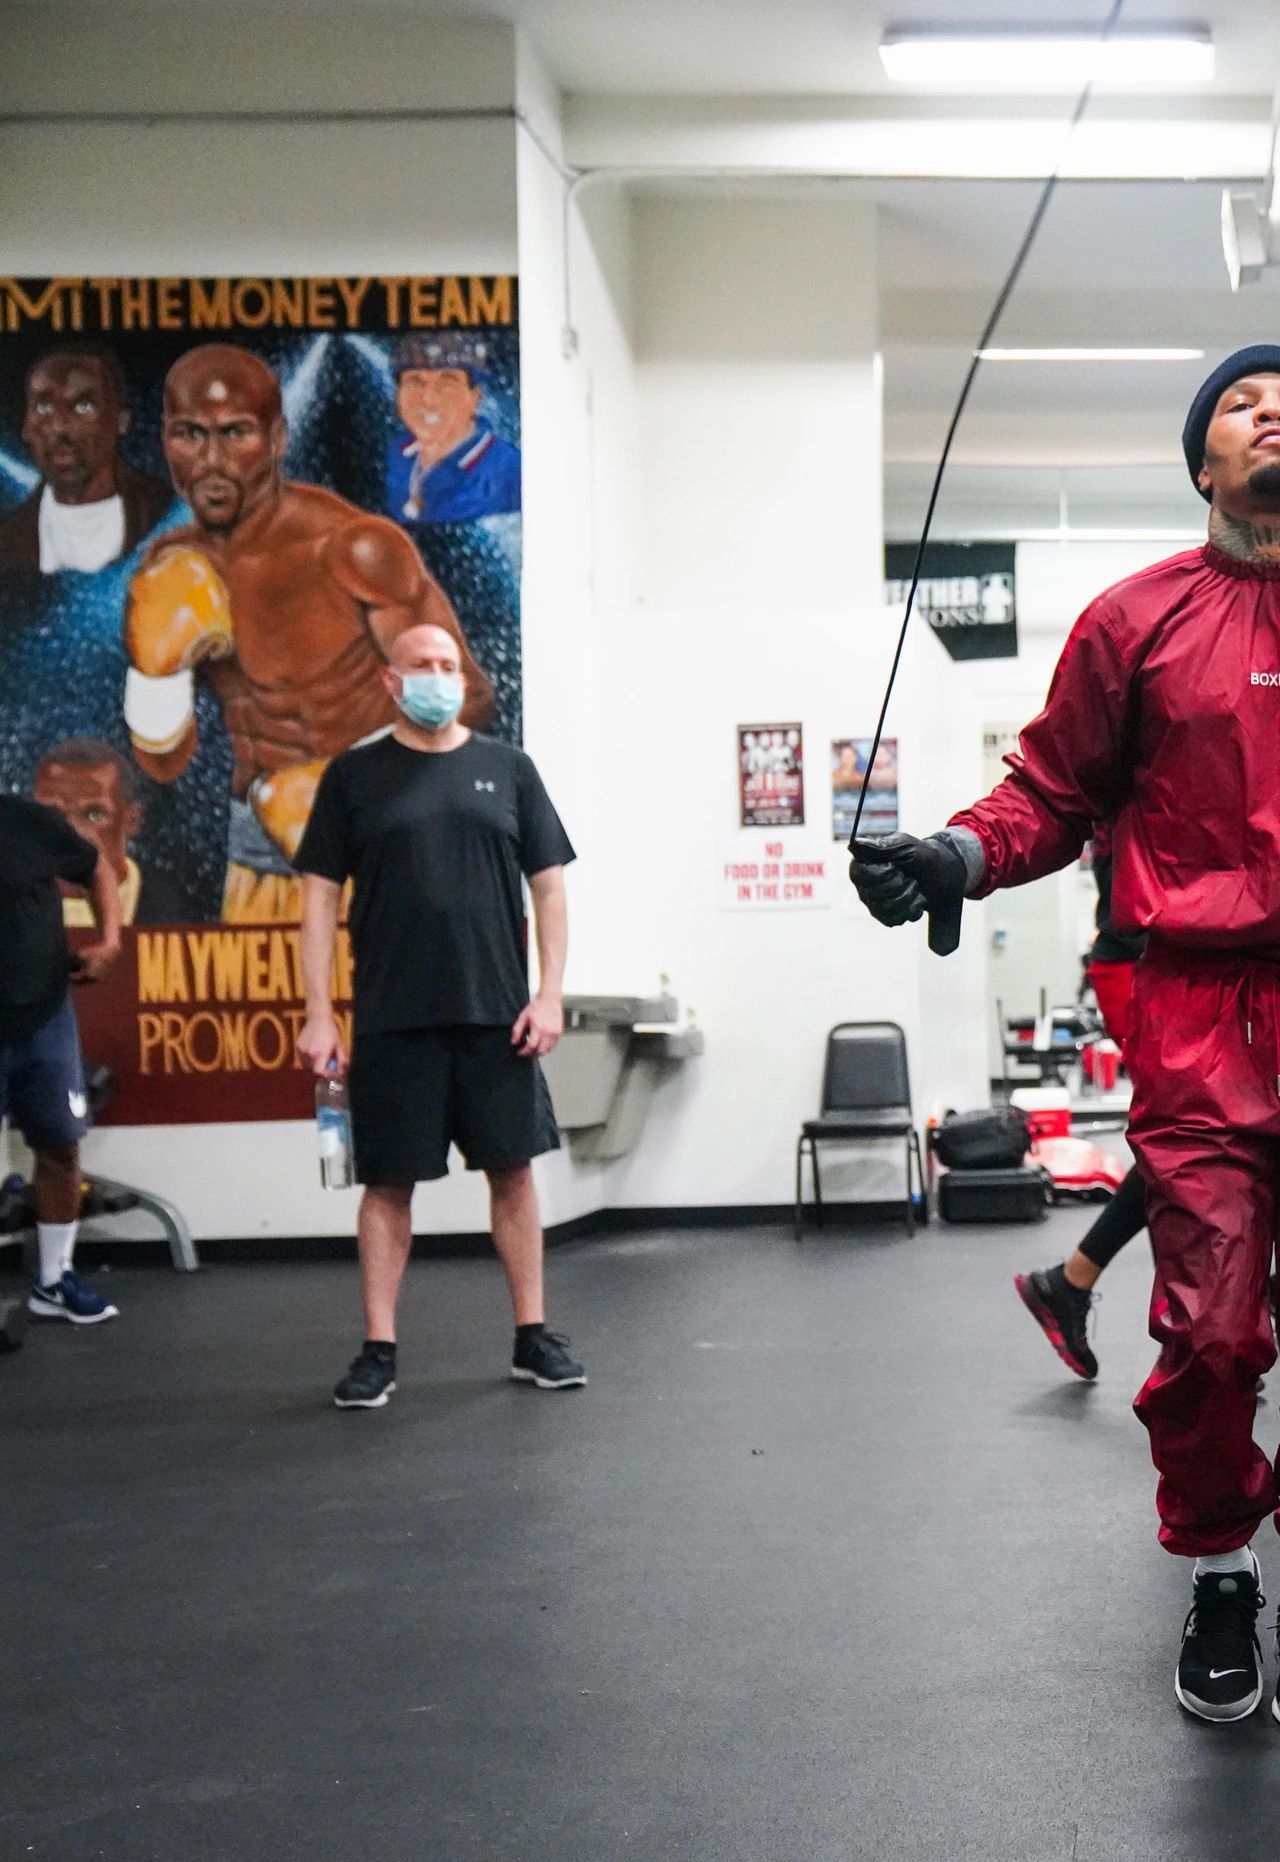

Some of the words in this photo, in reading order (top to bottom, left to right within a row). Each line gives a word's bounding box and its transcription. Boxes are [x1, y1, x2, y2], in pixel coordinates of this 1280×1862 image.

[0, 279, 82, 331] MT
[90, 278, 183, 330] THE
[190, 278, 371, 329] MONEY
[379, 276, 512, 328] TEAM
[765, 842, 784, 858] NO
[724, 863, 759, 880] FOOD
[763, 862, 780, 879] OR
[784, 861, 825, 878] DRINK
[738, 885, 750, 901] IN
[756, 884, 778, 900] THE
[783, 882, 813, 899] GYM
